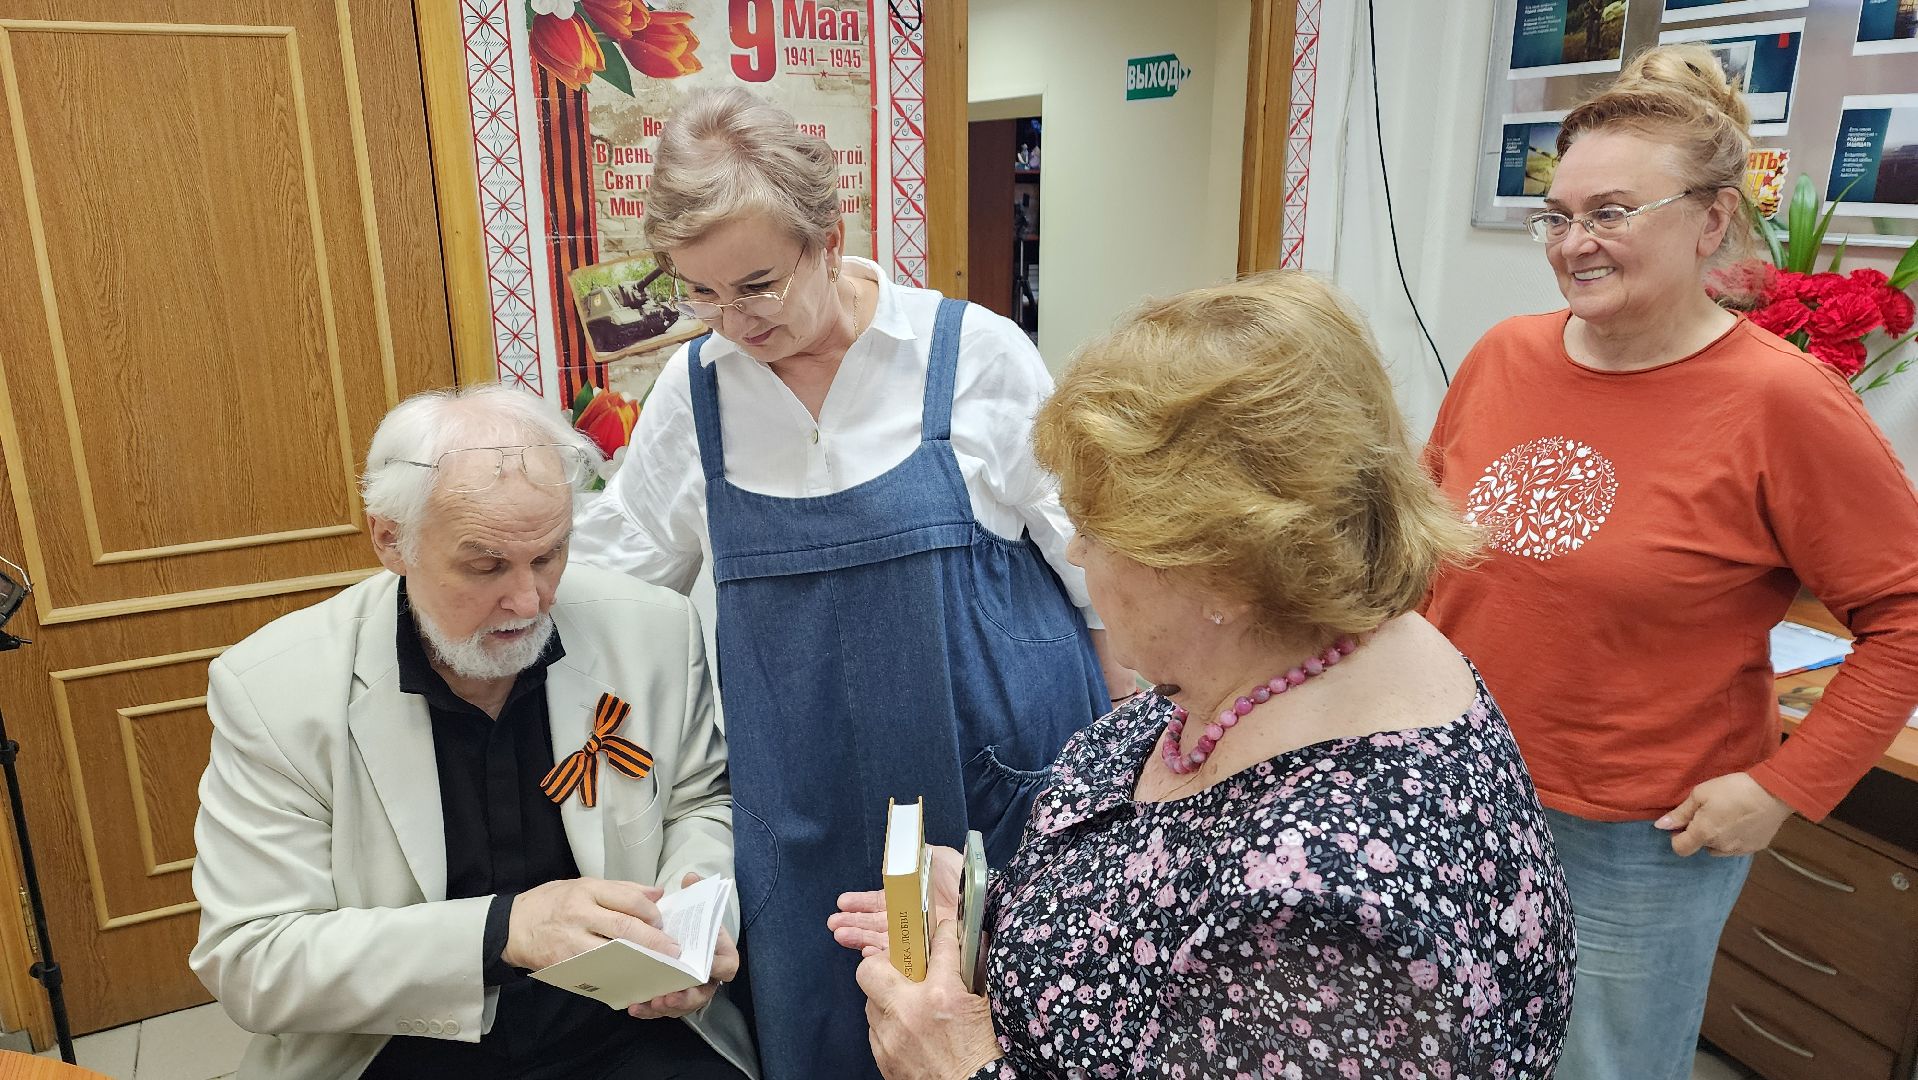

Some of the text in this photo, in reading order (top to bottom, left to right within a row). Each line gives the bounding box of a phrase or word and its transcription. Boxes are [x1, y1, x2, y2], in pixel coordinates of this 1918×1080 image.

[729, 0, 861, 82] 9 Мая
[1127, 60, 1179, 92] ВЫХОД
[643, 117, 663, 137] Не
[596, 143, 607, 163] В
[615, 147, 654, 165] день
[609, 197, 644, 218] Мир
[903, 947, 913, 981] УЗЫКА
